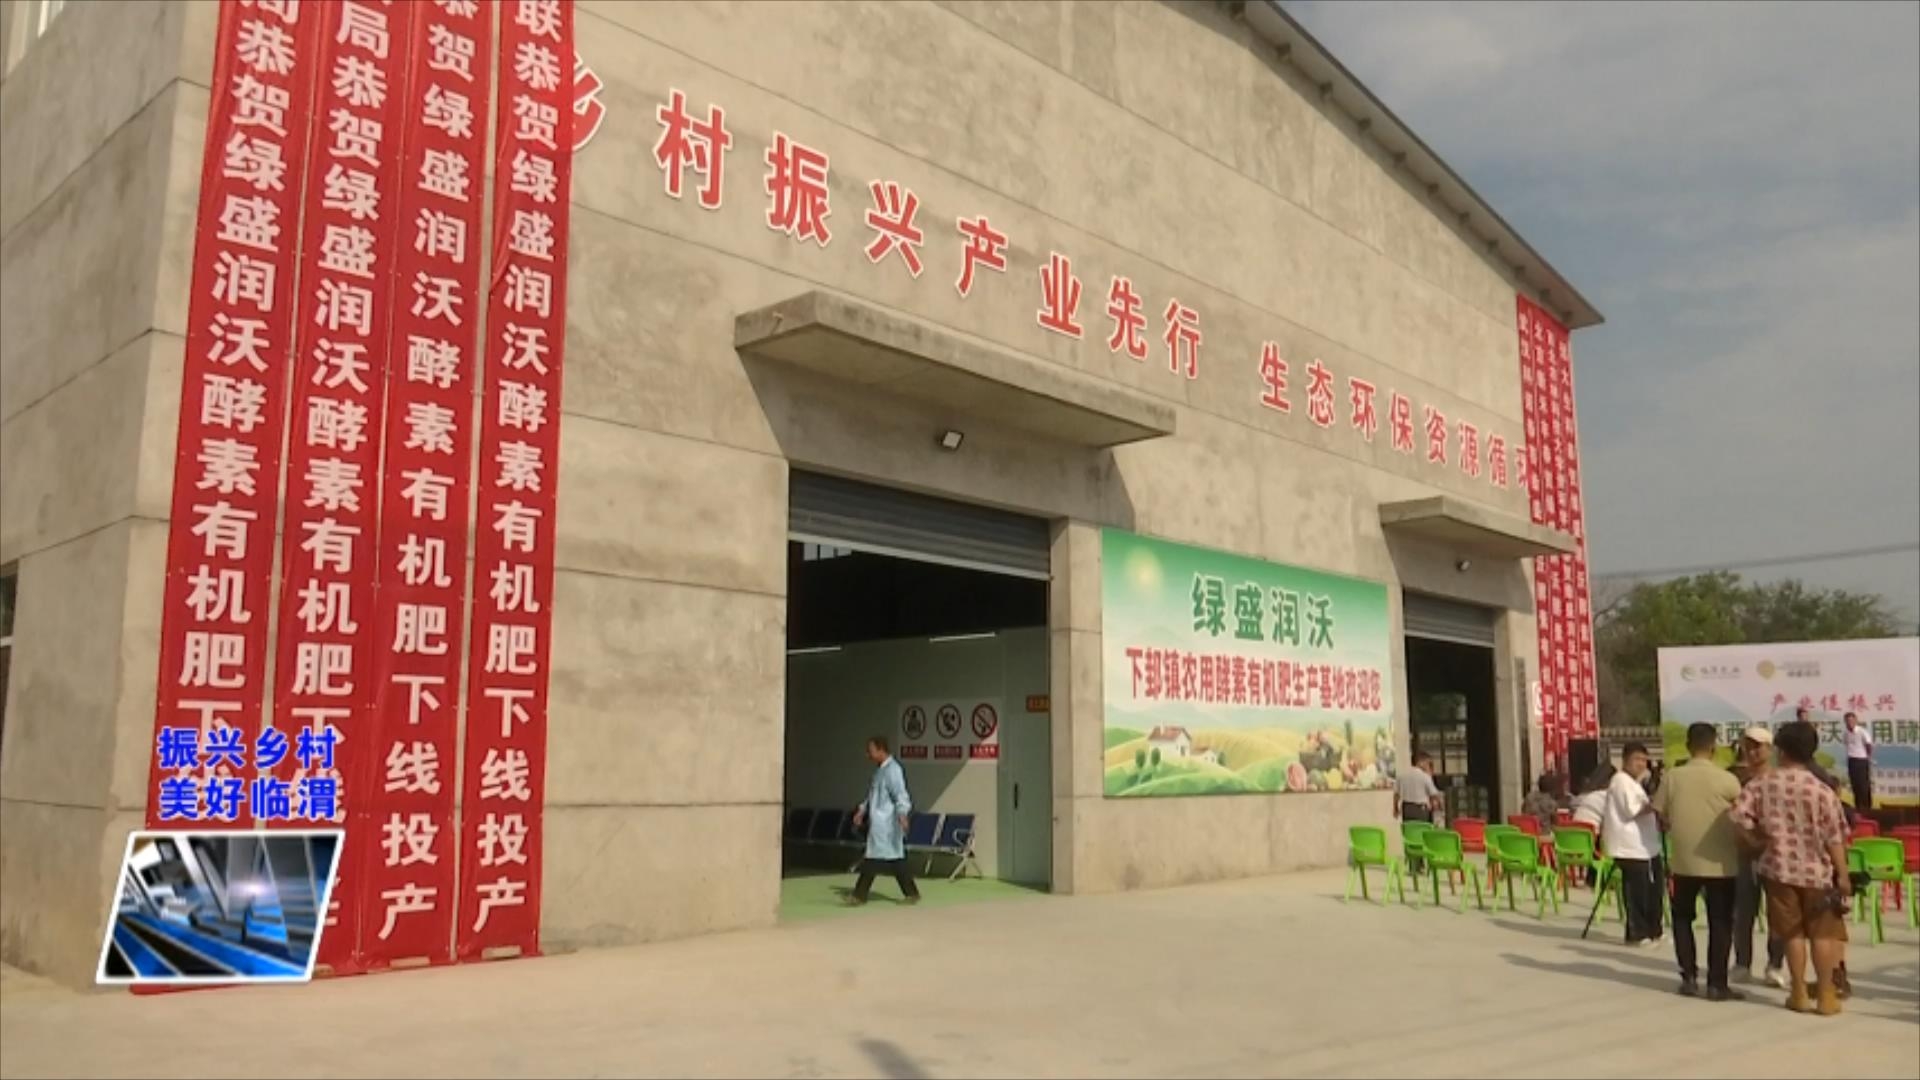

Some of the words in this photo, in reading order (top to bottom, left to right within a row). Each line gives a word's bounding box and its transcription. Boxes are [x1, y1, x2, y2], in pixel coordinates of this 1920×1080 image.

[160, 0, 298, 824] 恭贺绿盛润沃酵素有机肥下
[474, 0, 563, 932] 联恭贺绿盛润沃酵素有机肥下线投产
[1190, 571, 1335, 649] 绿盛润沃
